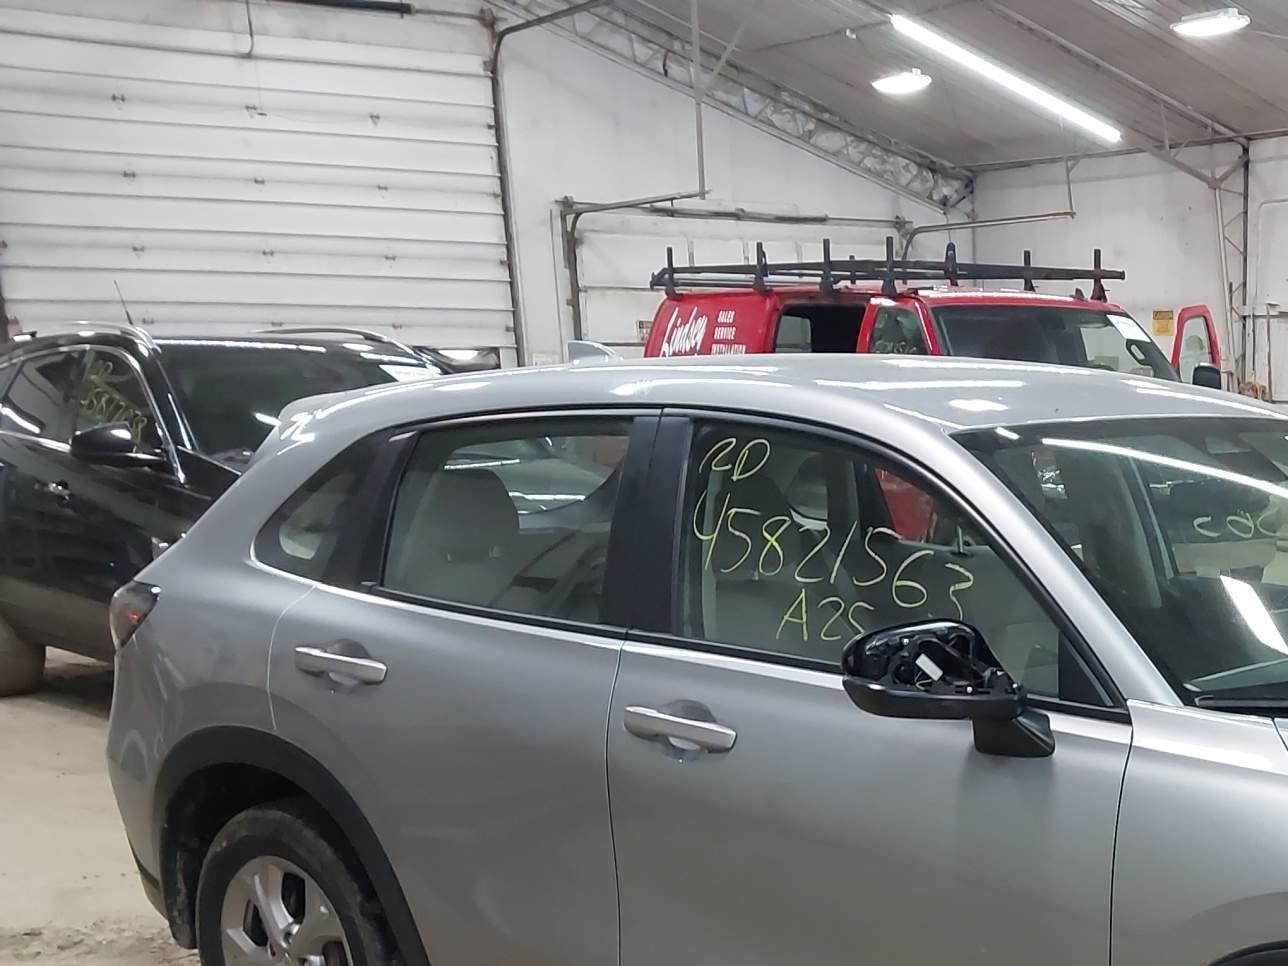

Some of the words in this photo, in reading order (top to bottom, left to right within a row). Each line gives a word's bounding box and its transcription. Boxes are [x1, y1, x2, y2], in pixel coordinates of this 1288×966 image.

[717, 310, 736, 324] SALES
[713, 326, 737, 340] SERVICE
[693, 490, 974, 622] 45821563
